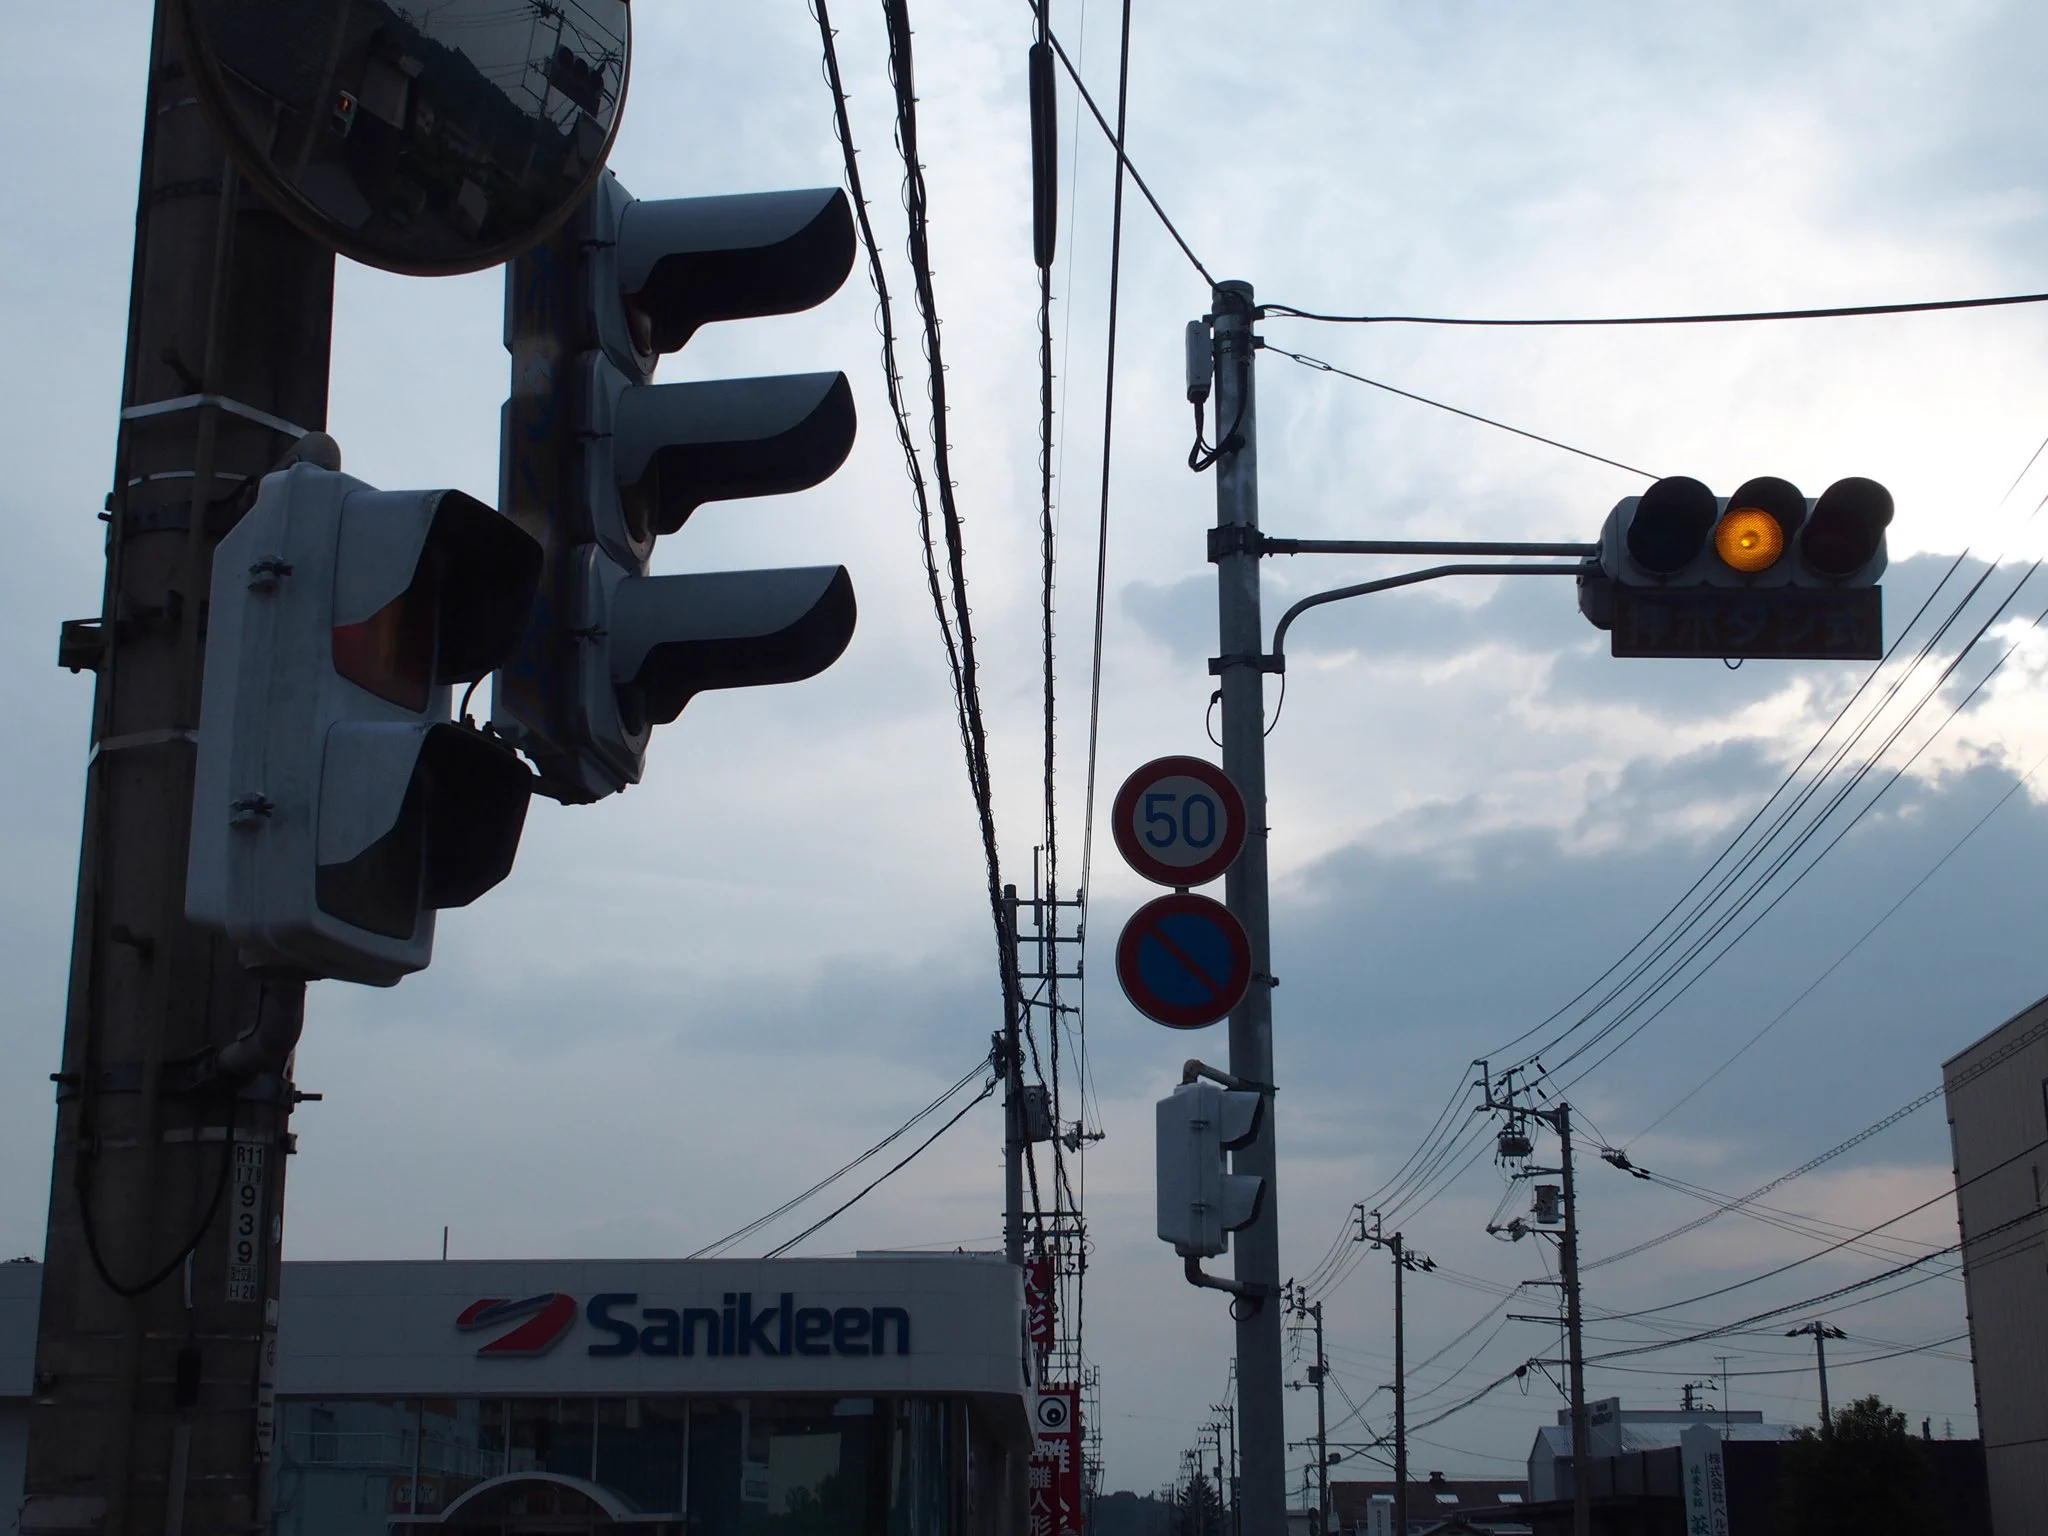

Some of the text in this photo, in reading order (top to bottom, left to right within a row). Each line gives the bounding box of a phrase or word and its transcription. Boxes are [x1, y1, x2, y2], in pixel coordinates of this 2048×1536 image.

[1625, 599, 1869, 650] 押ボタン式
[1145, 794, 1216, 848] 50
[237, 1146, 262, 1165] R11
[586, 1291, 910, 1357] Sanikleen
